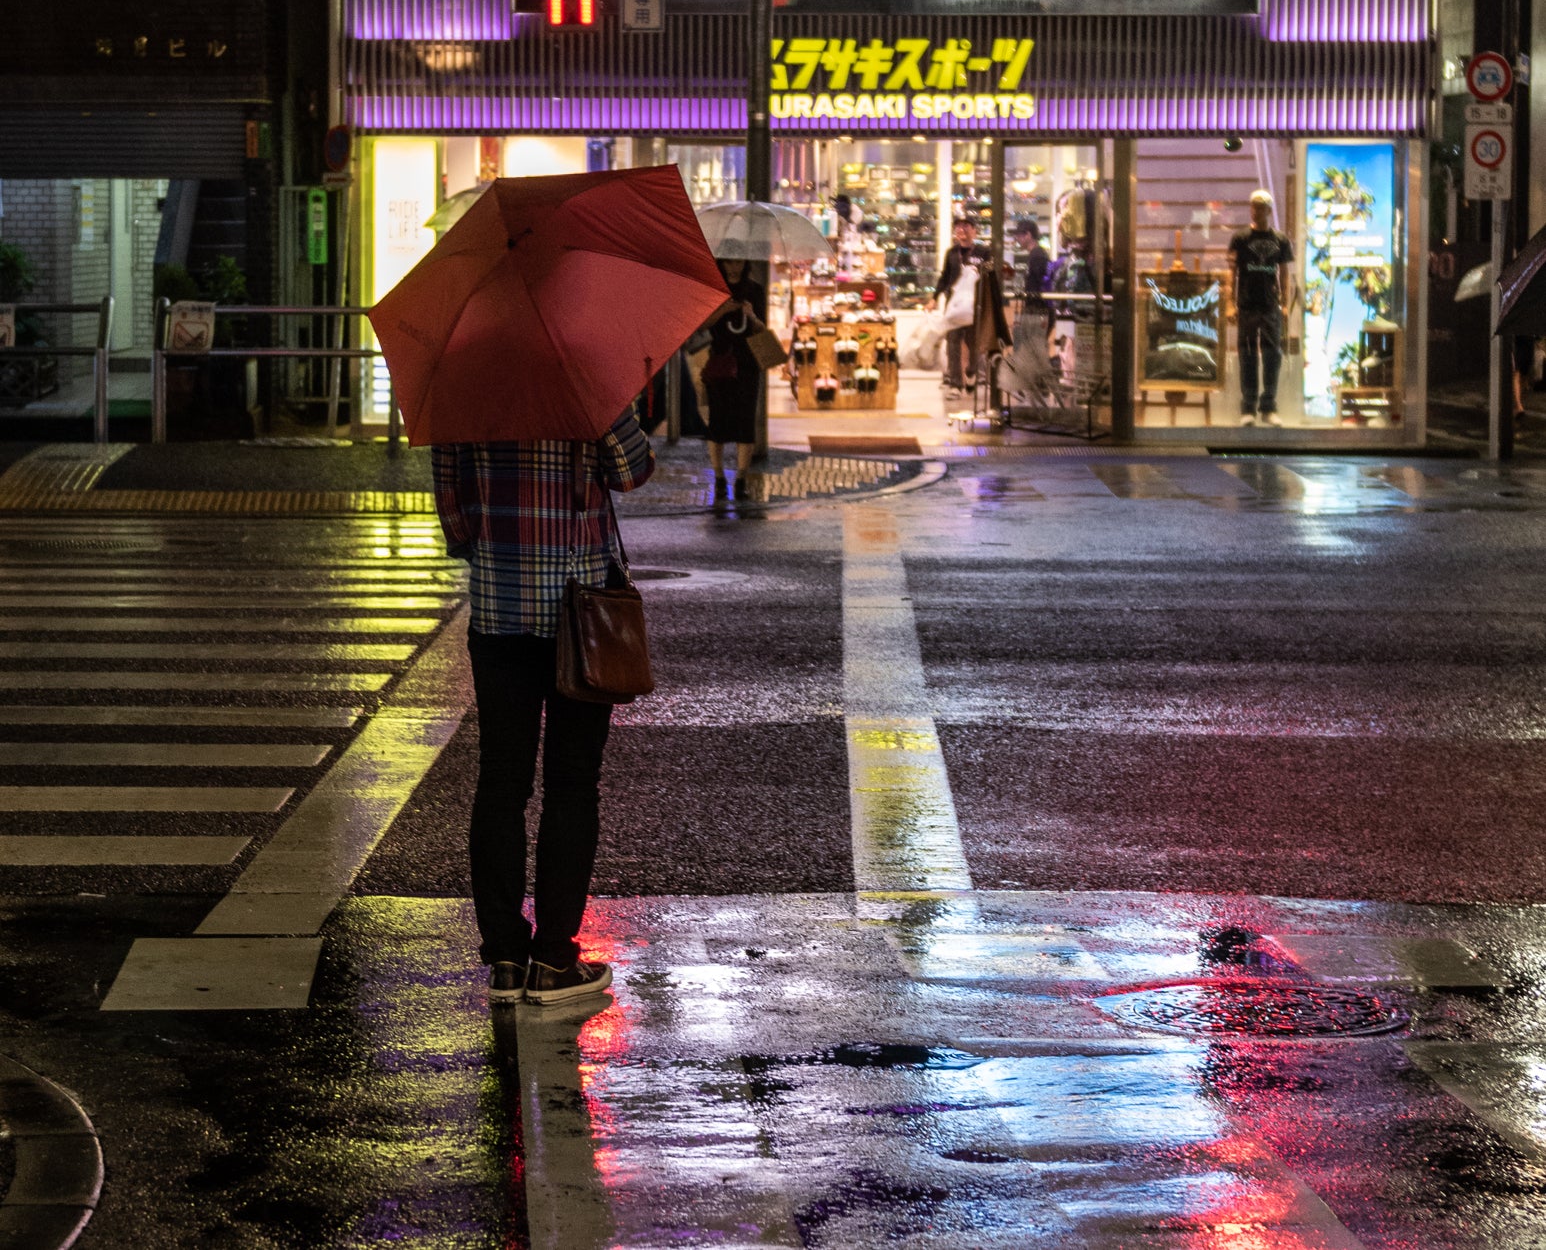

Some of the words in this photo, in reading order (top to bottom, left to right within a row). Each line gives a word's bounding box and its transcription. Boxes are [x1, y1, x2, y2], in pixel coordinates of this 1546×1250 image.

[770, 94, 907, 119] URASAKI
[911, 94, 1035, 120] SPORTS
[1478, 139, 1500, 159] 30
